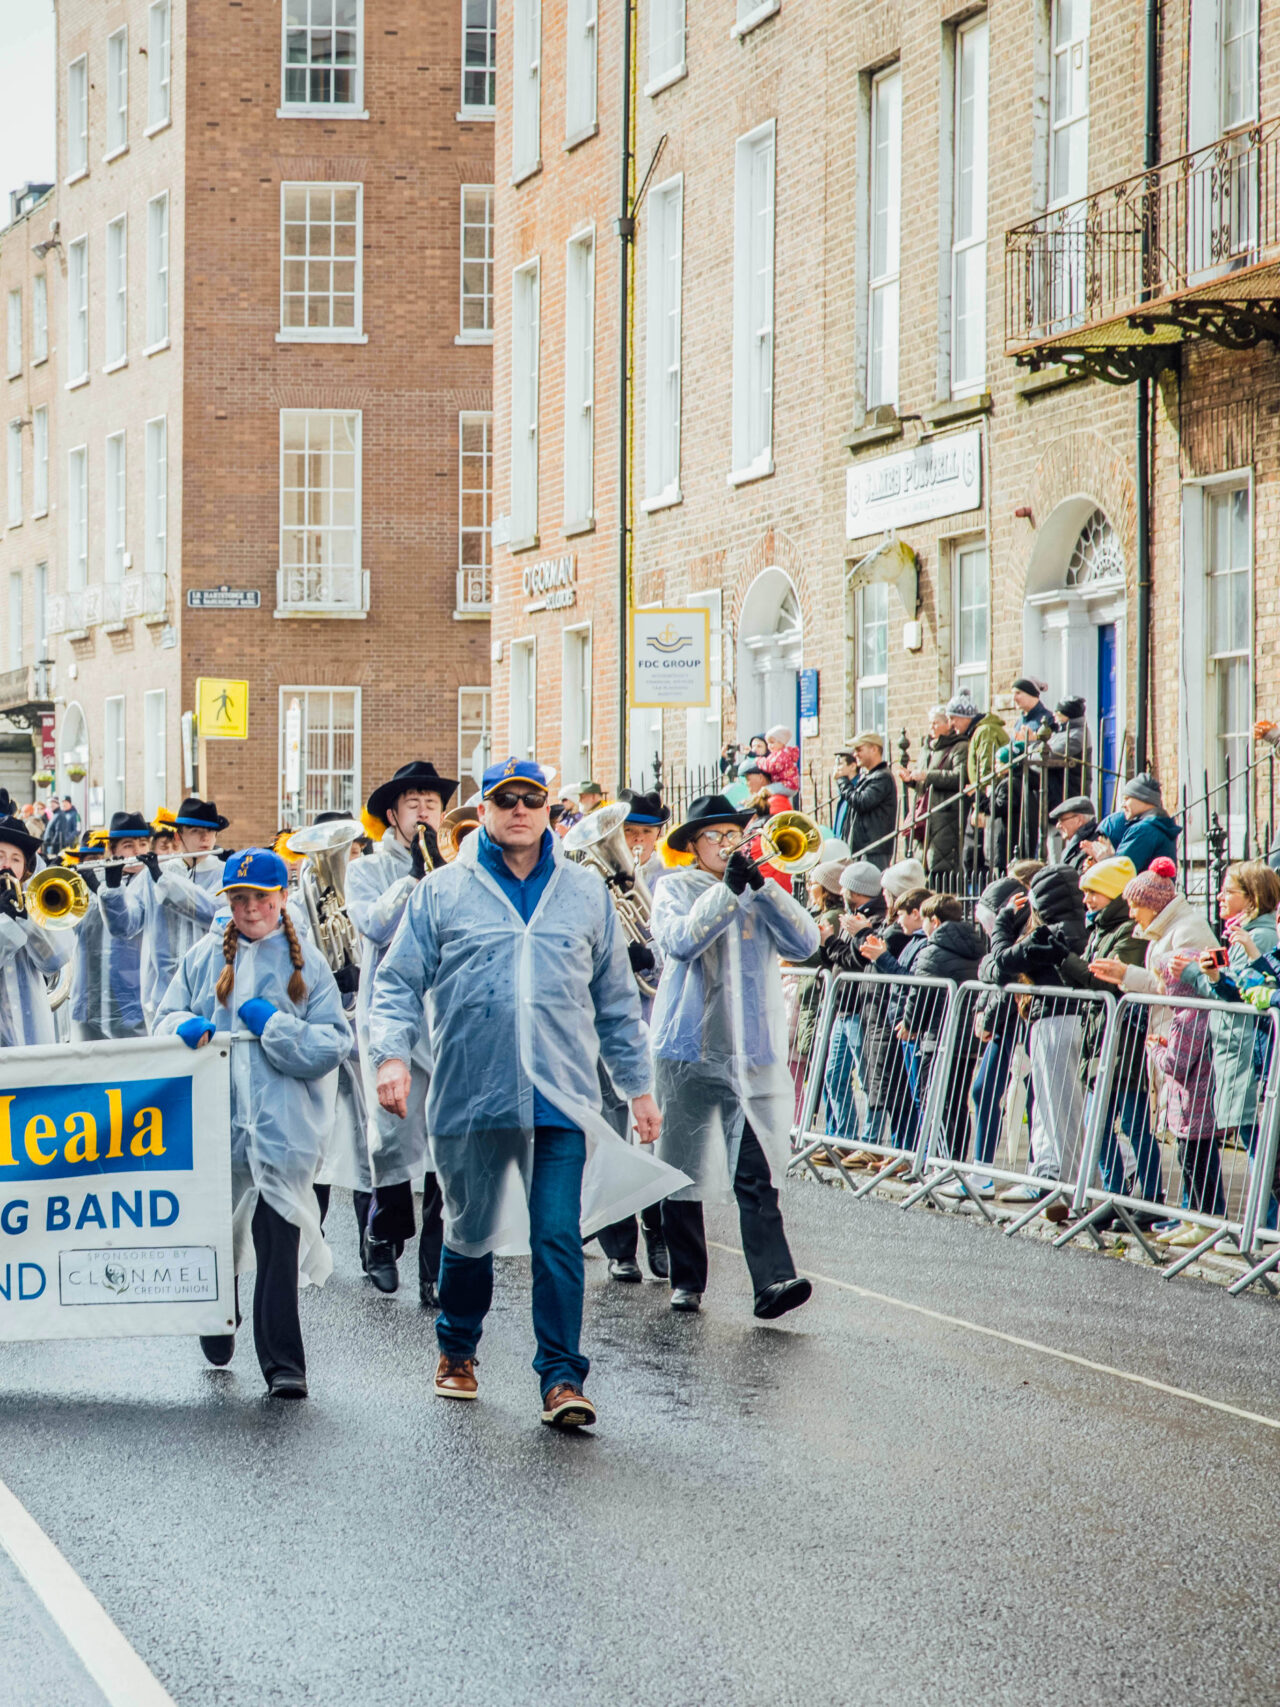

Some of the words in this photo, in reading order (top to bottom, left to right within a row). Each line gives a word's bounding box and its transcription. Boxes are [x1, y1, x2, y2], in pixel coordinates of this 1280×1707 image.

[638, 659, 659, 668] FDC
[662, 659, 701, 668] GROUP
[45, 1189, 181, 1232] BAND
[87, 1250, 165, 1262] SPONSORED
[173, 1250, 188, 1259] BY
[134, 1286, 171, 1295] CREDIT
[174, 1284, 209, 1294] UNION
